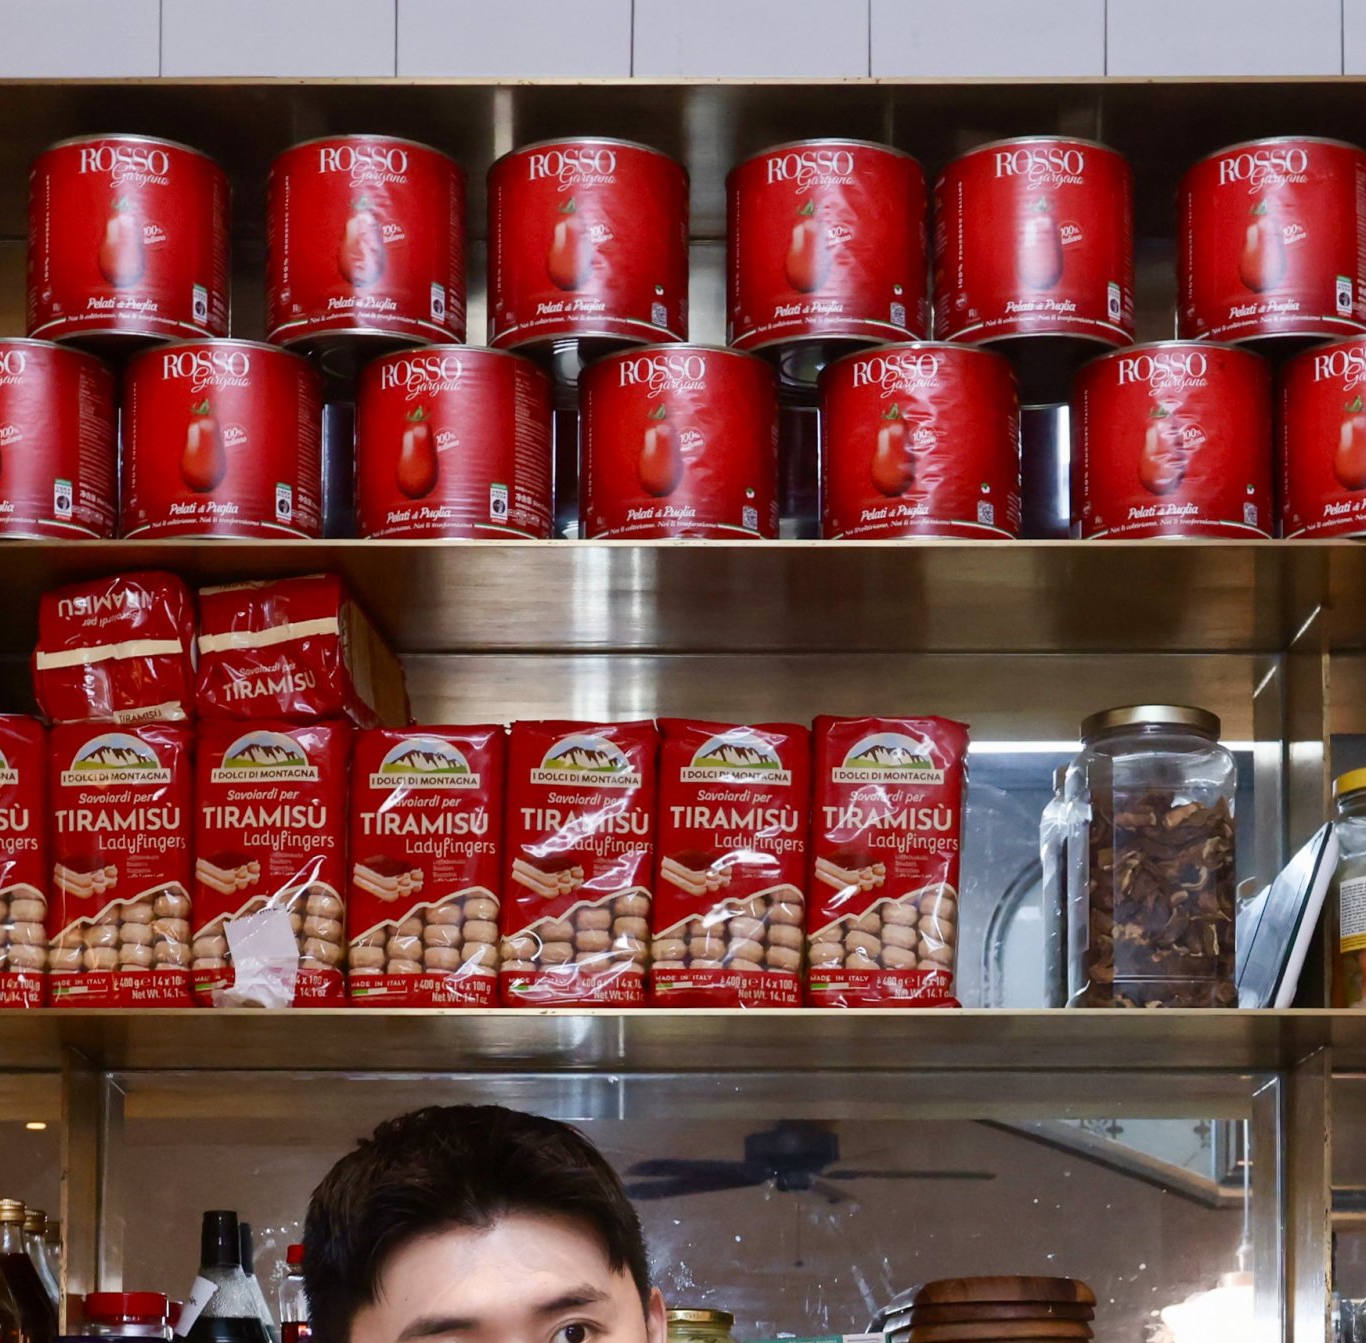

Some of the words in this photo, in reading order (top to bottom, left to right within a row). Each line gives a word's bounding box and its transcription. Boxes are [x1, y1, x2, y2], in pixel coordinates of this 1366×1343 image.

[79, 148, 170, 174] ROSSO
[318, 146, 408, 173] ROSSO
[529, 151, 616, 180] ROSSO
[995, 149, 1084, 177] ROSSO
[1218, 149, 1307, 184] ROSSO
[127, 298, 159, 312] Puglia
[163, 352, 250, 381] ROSSO
[381, 357, 463, 388] ROSSO
[619, 357, 706, 387] ROSSO
[1118, 353, 1207, 385] ROSSO
[226, 788, 276, 801] Savoiardi
[278, 789, 299, 802] per
[55, 801, 181, 833] TIRAMISÙ
[203, 801, 327, 830] TIRAMISÙ
[360, 808, 489, 837] TIRAMISÙ
[521, 806, 649, 835] TIRAMISÙ
[670, 802, 799, 834] TIRAMISÙ
[823, 803, 953, 831] TIRAMISÙ
[243, 831, 335, 850] Ladyfingers
[406, 836, 496, 857] Ladyfingers
[715, 832, 804, 854] Ladyfingers
[868, 832, 958, 854] Ladyfingers
